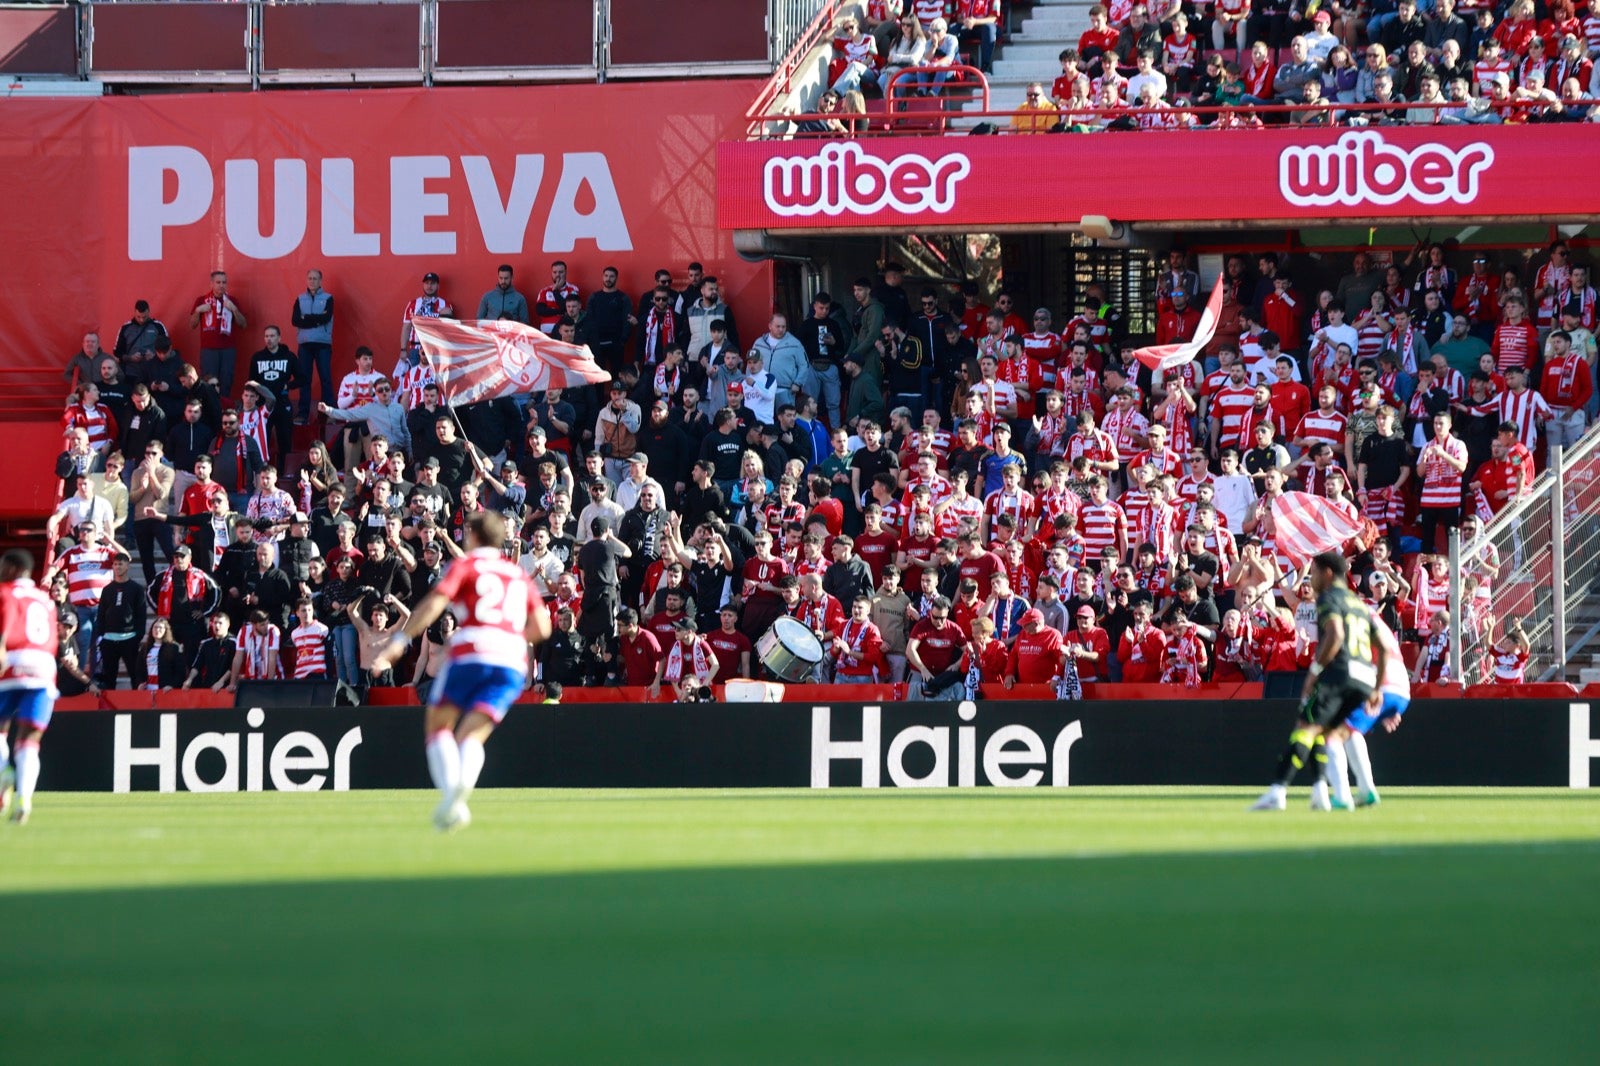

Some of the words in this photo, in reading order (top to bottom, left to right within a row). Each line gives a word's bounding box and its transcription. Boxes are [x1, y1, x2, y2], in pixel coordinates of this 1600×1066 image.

[128, 145, 633, 261] PULEVA
[763, 142, 971, 217] wiber
[1279, 130, 1495, 207] wiber
[474, 573, 528, 633] 24
[113, 708, 363, 793] Haier
[811, 701, 1084, 788] Haier
